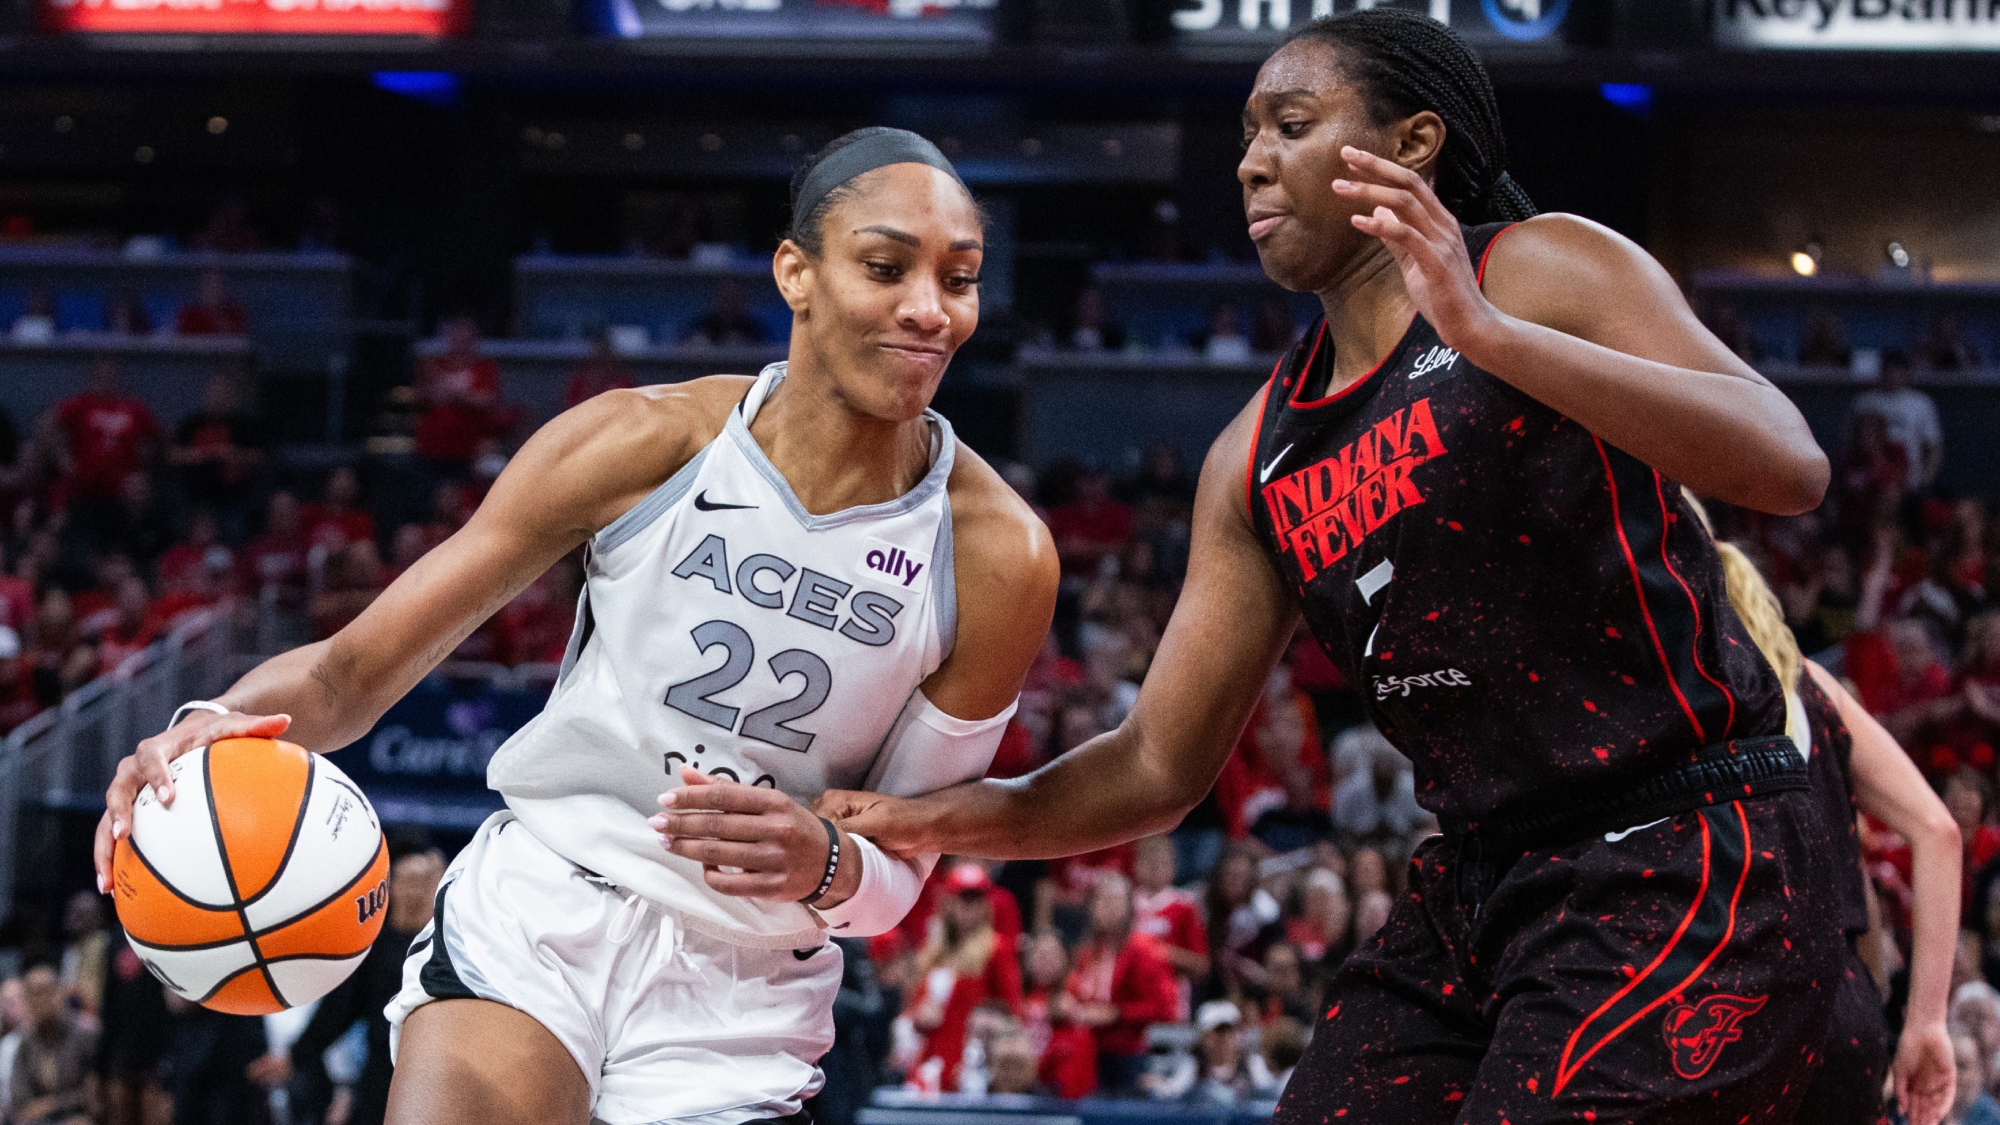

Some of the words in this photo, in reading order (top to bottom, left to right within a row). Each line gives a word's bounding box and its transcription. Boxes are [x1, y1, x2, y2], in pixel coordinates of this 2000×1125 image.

[1408, 345, 1460, 379] Lilly
[1261, 397, 1448, 553] INDIANA
[1288, 455, 1426, 583] FEVER
[671, 533, 905, 647] ACES
[865, 547, 924, 586] ally
[664, 619, 832, 753] 22
[819, 844, 839, 895] RENEW
